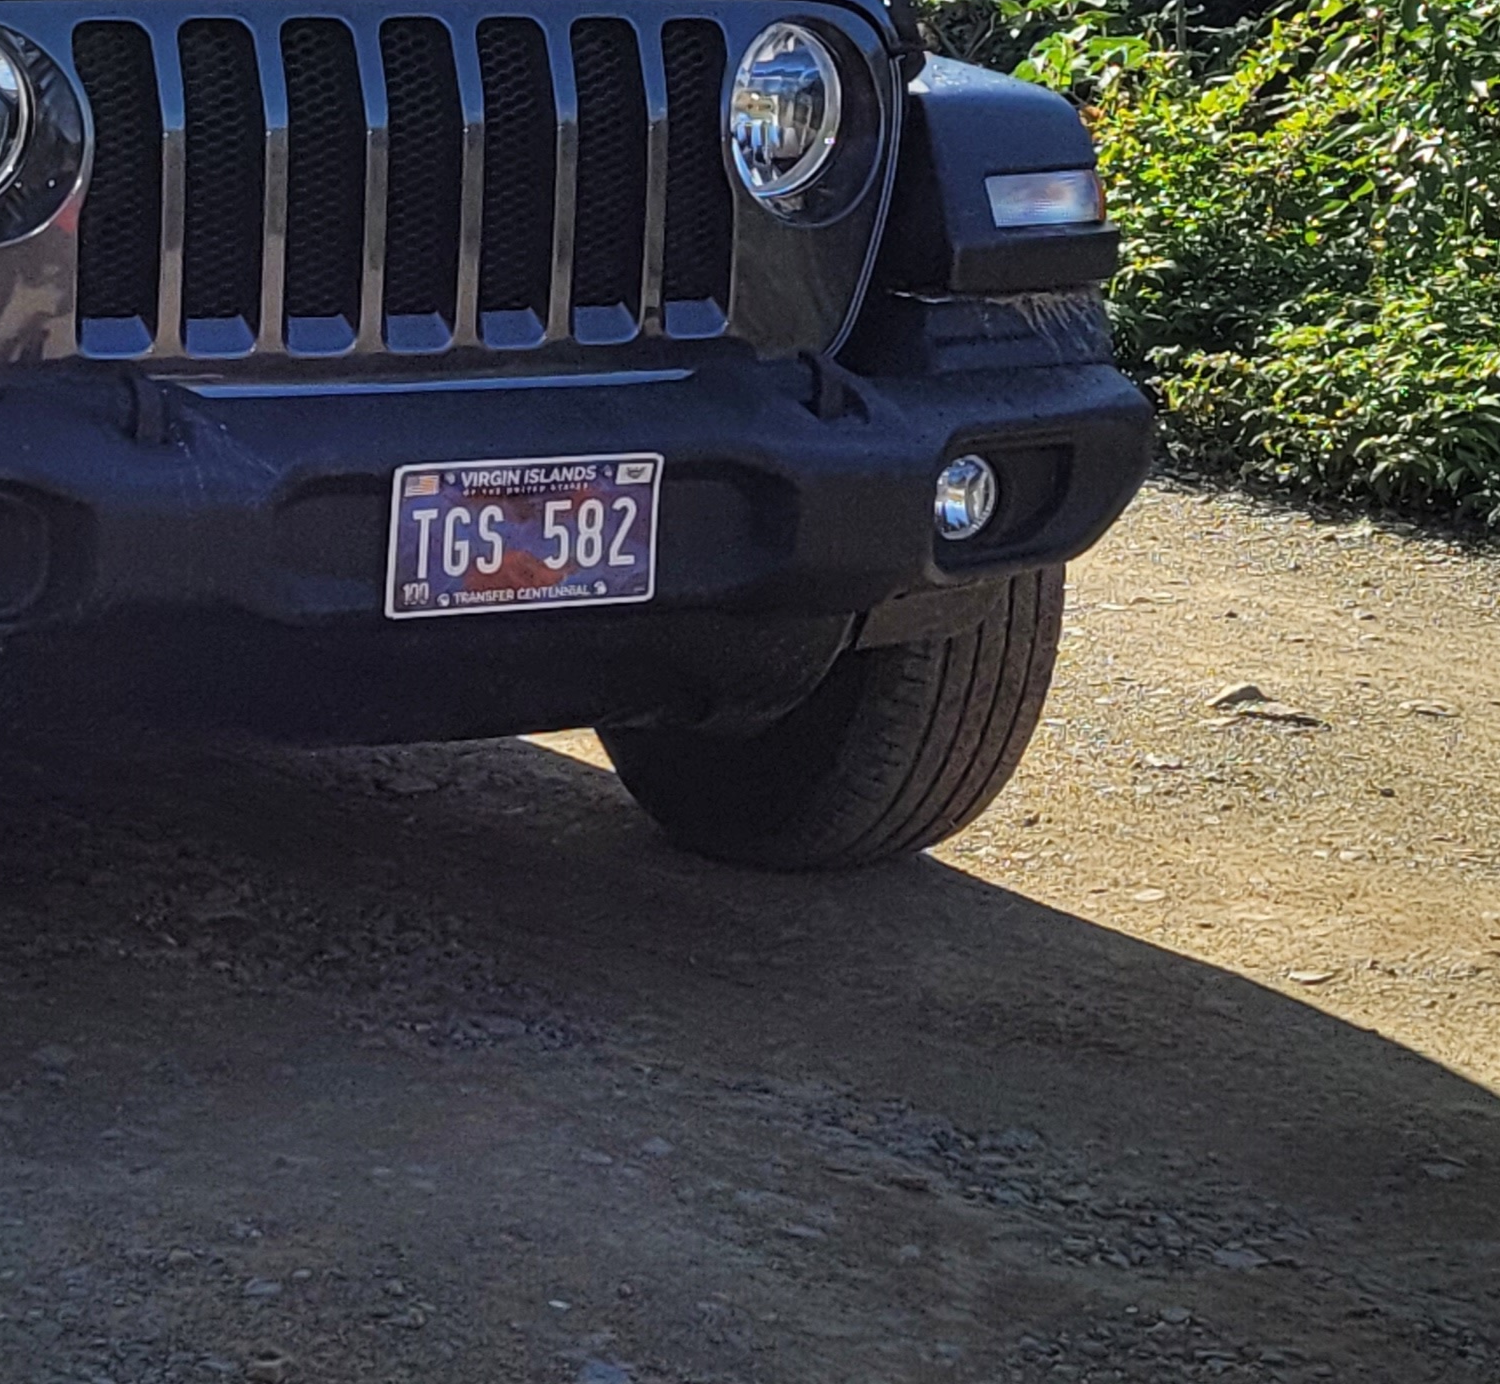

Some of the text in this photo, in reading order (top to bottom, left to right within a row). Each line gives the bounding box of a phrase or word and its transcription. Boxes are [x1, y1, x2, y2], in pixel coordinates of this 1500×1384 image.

[461, 465, 597, 487] VIRGIN ISLANDS
[413, 497, 637, 579] TGS 582
[453, 590, 515, 604] TRANSFER
